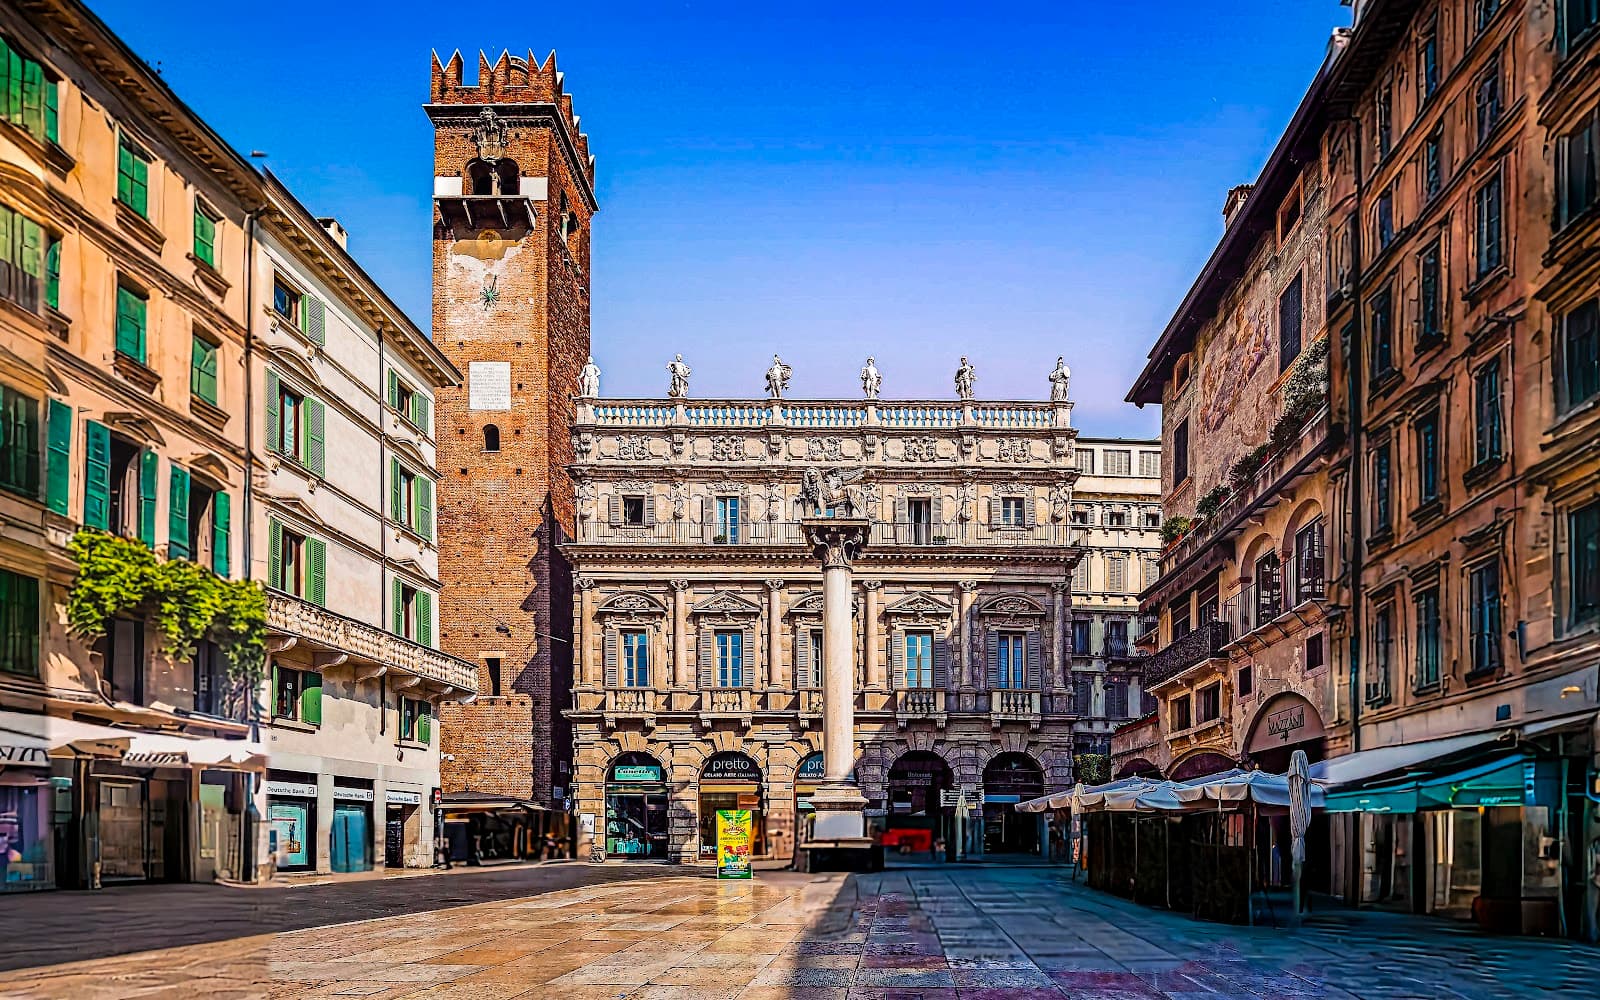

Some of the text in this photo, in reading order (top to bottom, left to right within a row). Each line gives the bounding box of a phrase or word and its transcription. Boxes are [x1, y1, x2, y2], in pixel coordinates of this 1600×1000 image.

[712, 758, 750, 771] pretto
[807, 758, 825, 771] pre
[266, 786, 292, 794] Deutsche
